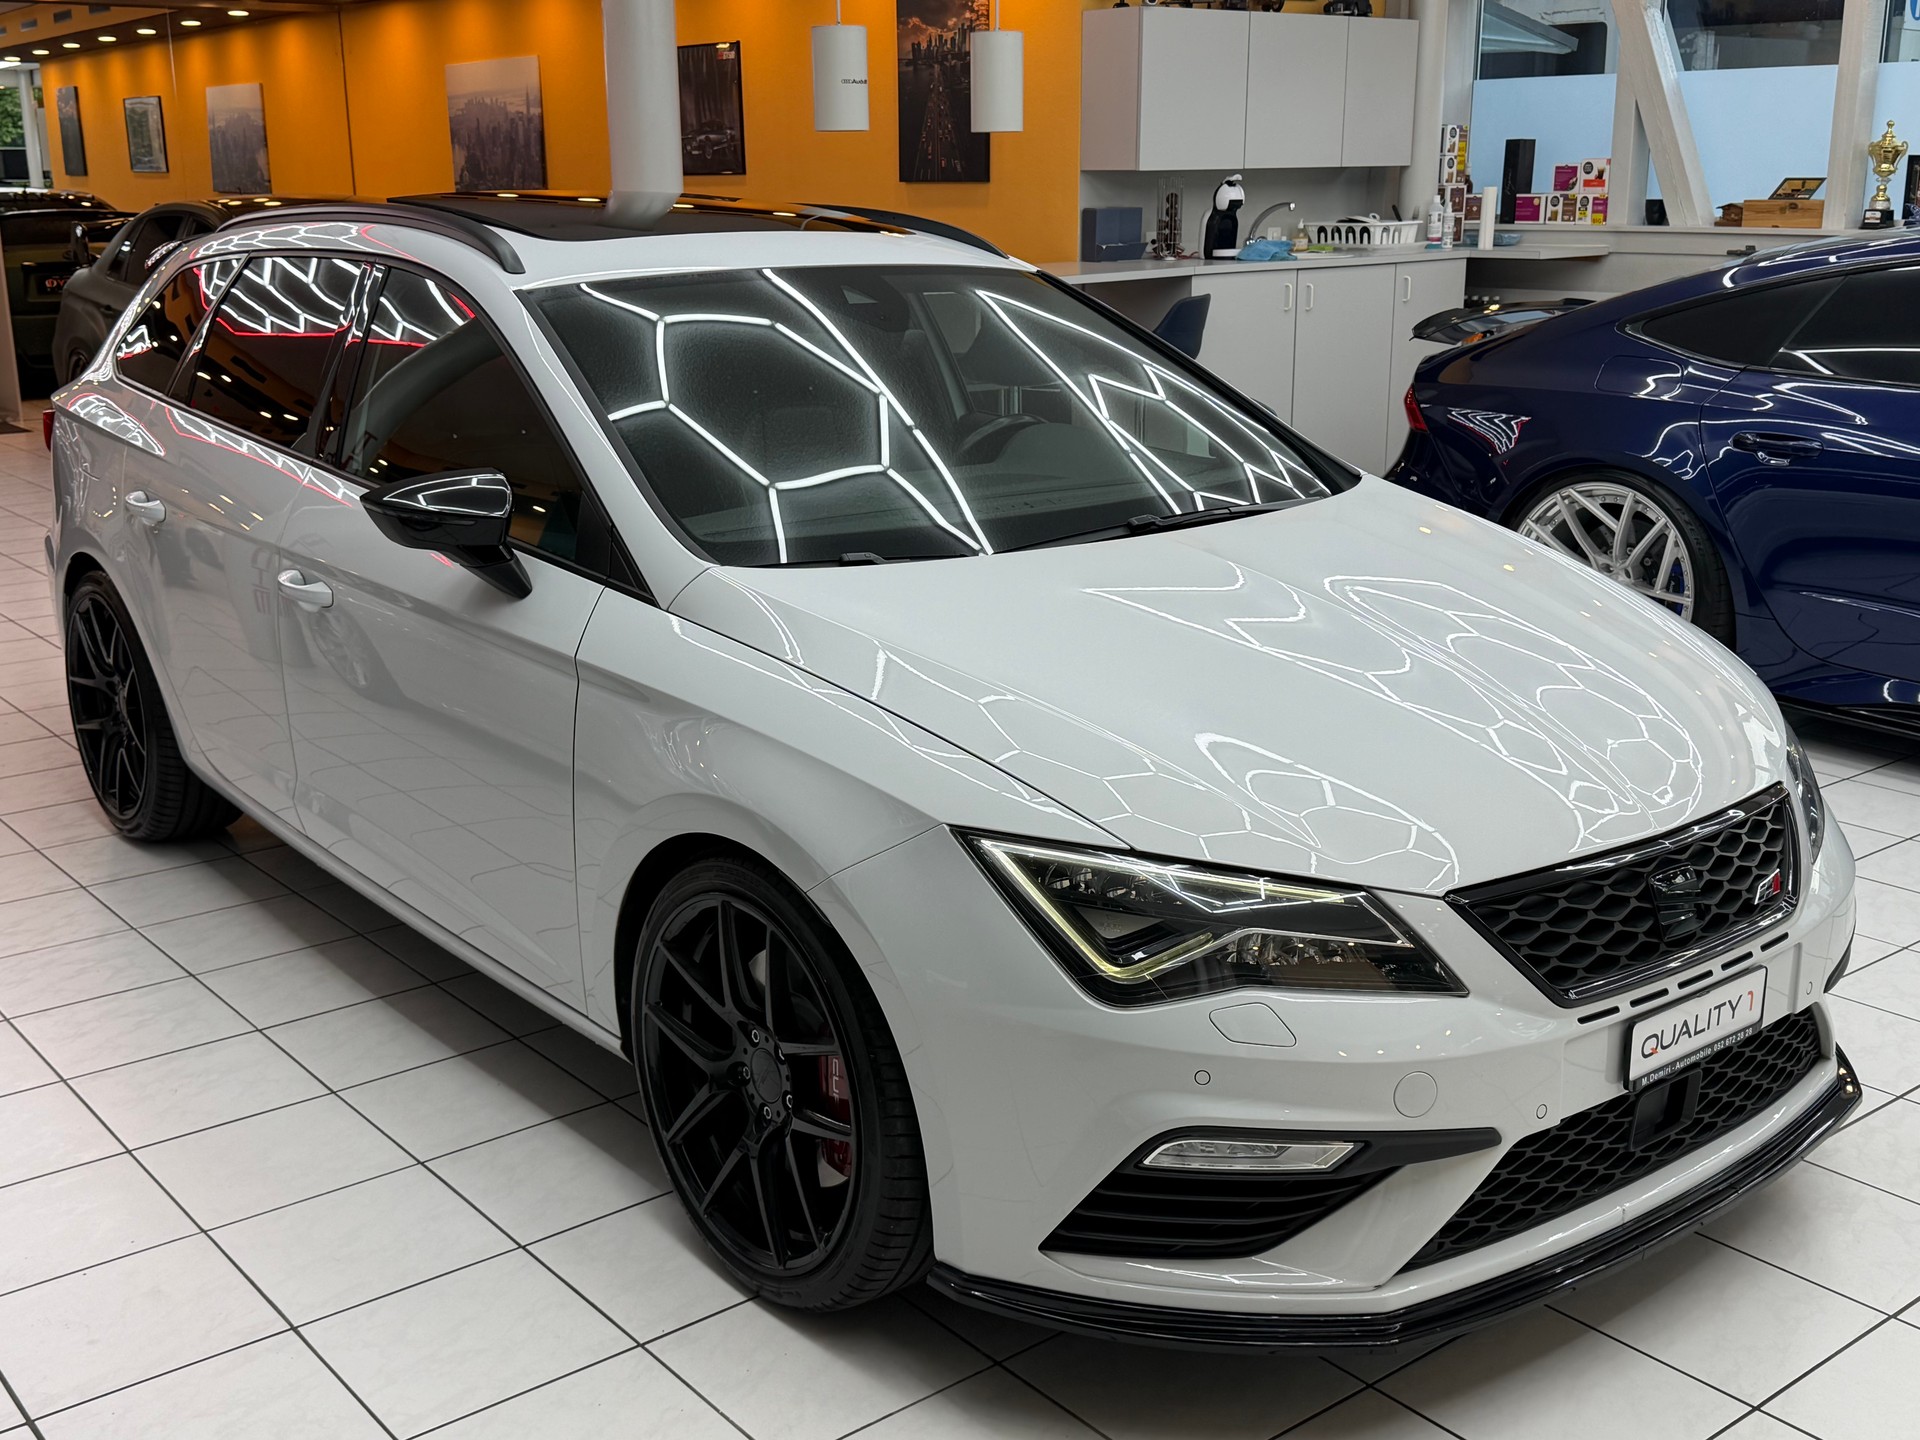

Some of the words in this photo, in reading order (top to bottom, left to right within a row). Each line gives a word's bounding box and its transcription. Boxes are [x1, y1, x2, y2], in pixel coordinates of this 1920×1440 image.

[1641, 994, 1743, 1059] QUALITY
[1747, 990, 1754, 1012] 1
[1641, 1077, 1650, 1087] M.
[1649, 1065, 1671, 1083] Demiri
[1675, 1046, 1712, 1070] Automobile
